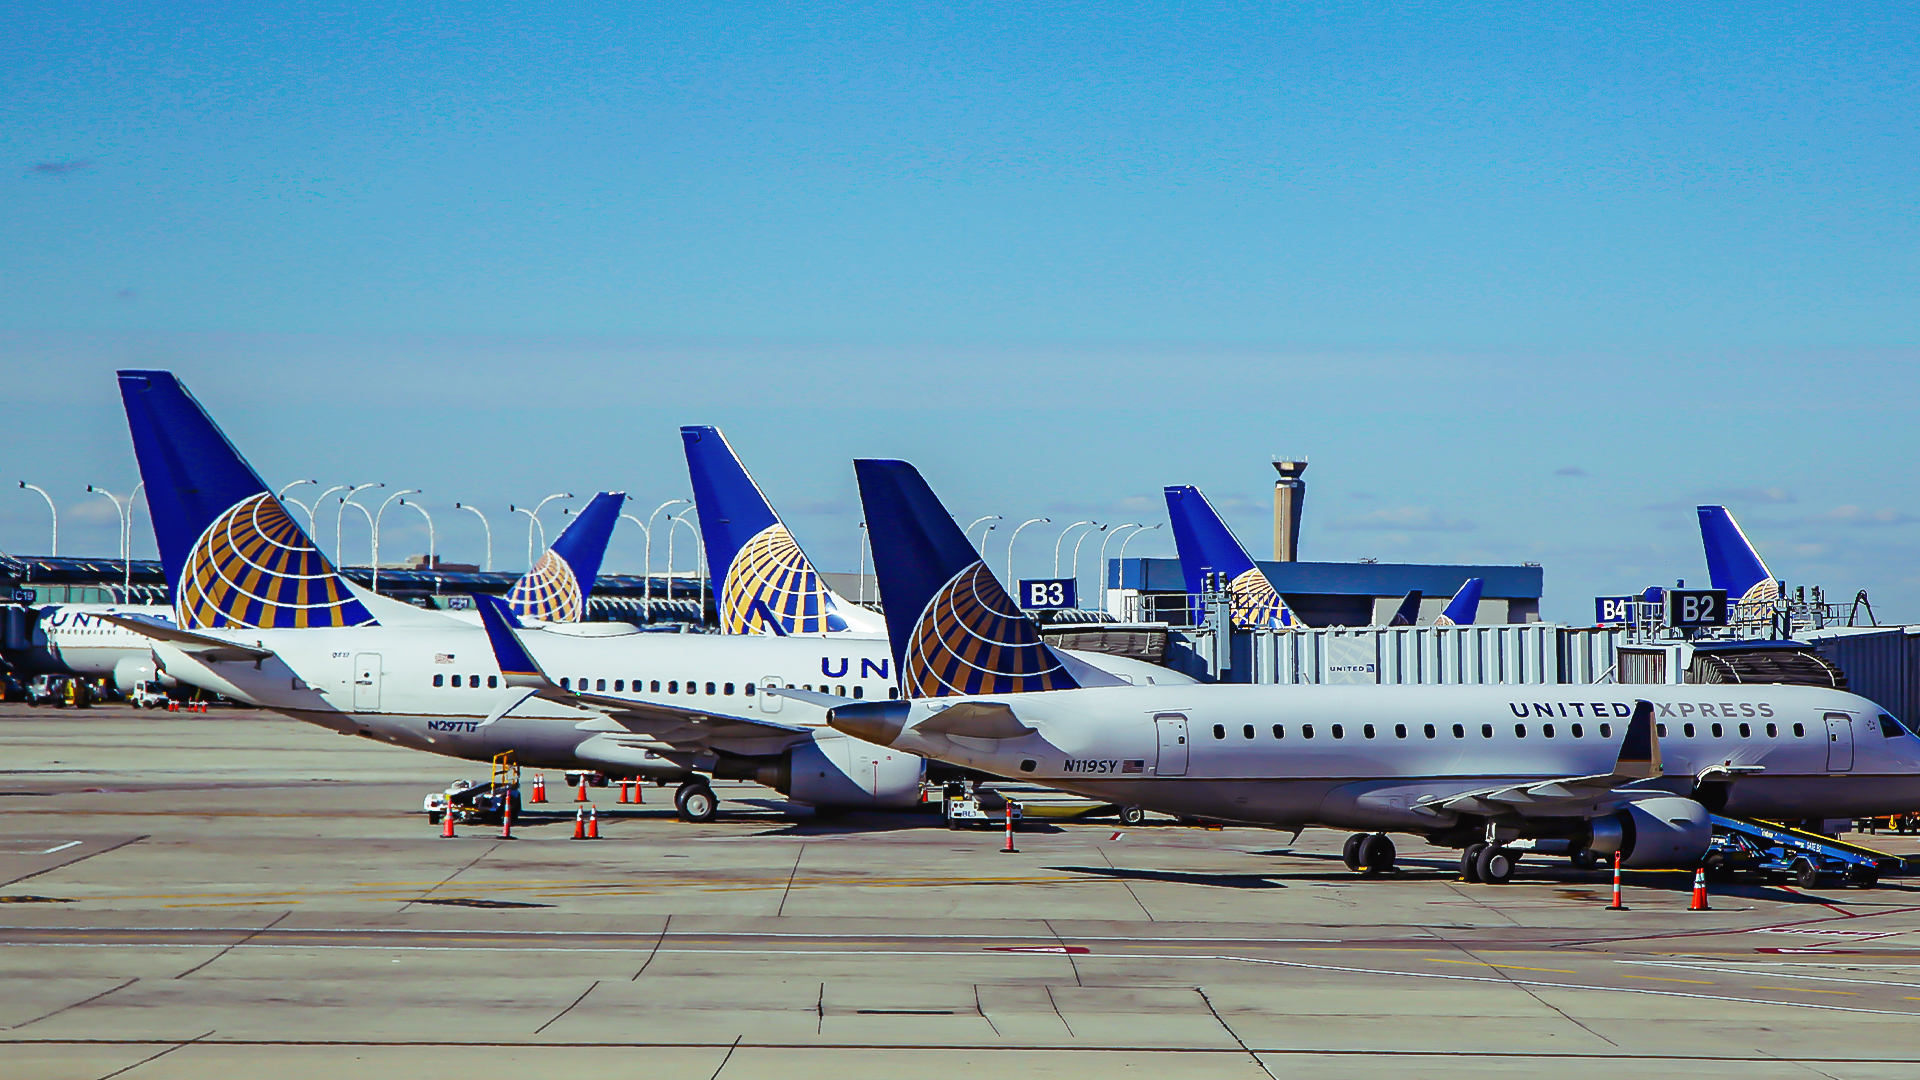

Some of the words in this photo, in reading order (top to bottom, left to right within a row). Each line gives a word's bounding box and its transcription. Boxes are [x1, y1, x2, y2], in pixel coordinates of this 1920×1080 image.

[15, 591, 34, 601] C19
[1031, 583, 1064, 606] B3
[1603, 599, 1626, 620] B4
[1683, 596, 1715, 621] B2
[1508, 702, 1631, 718] UNITED
[1654, 702, 1775, 718] XPRESS
[427, 720, 479, 733] N29717
[1063, 759, 1118, 774] N119SY
